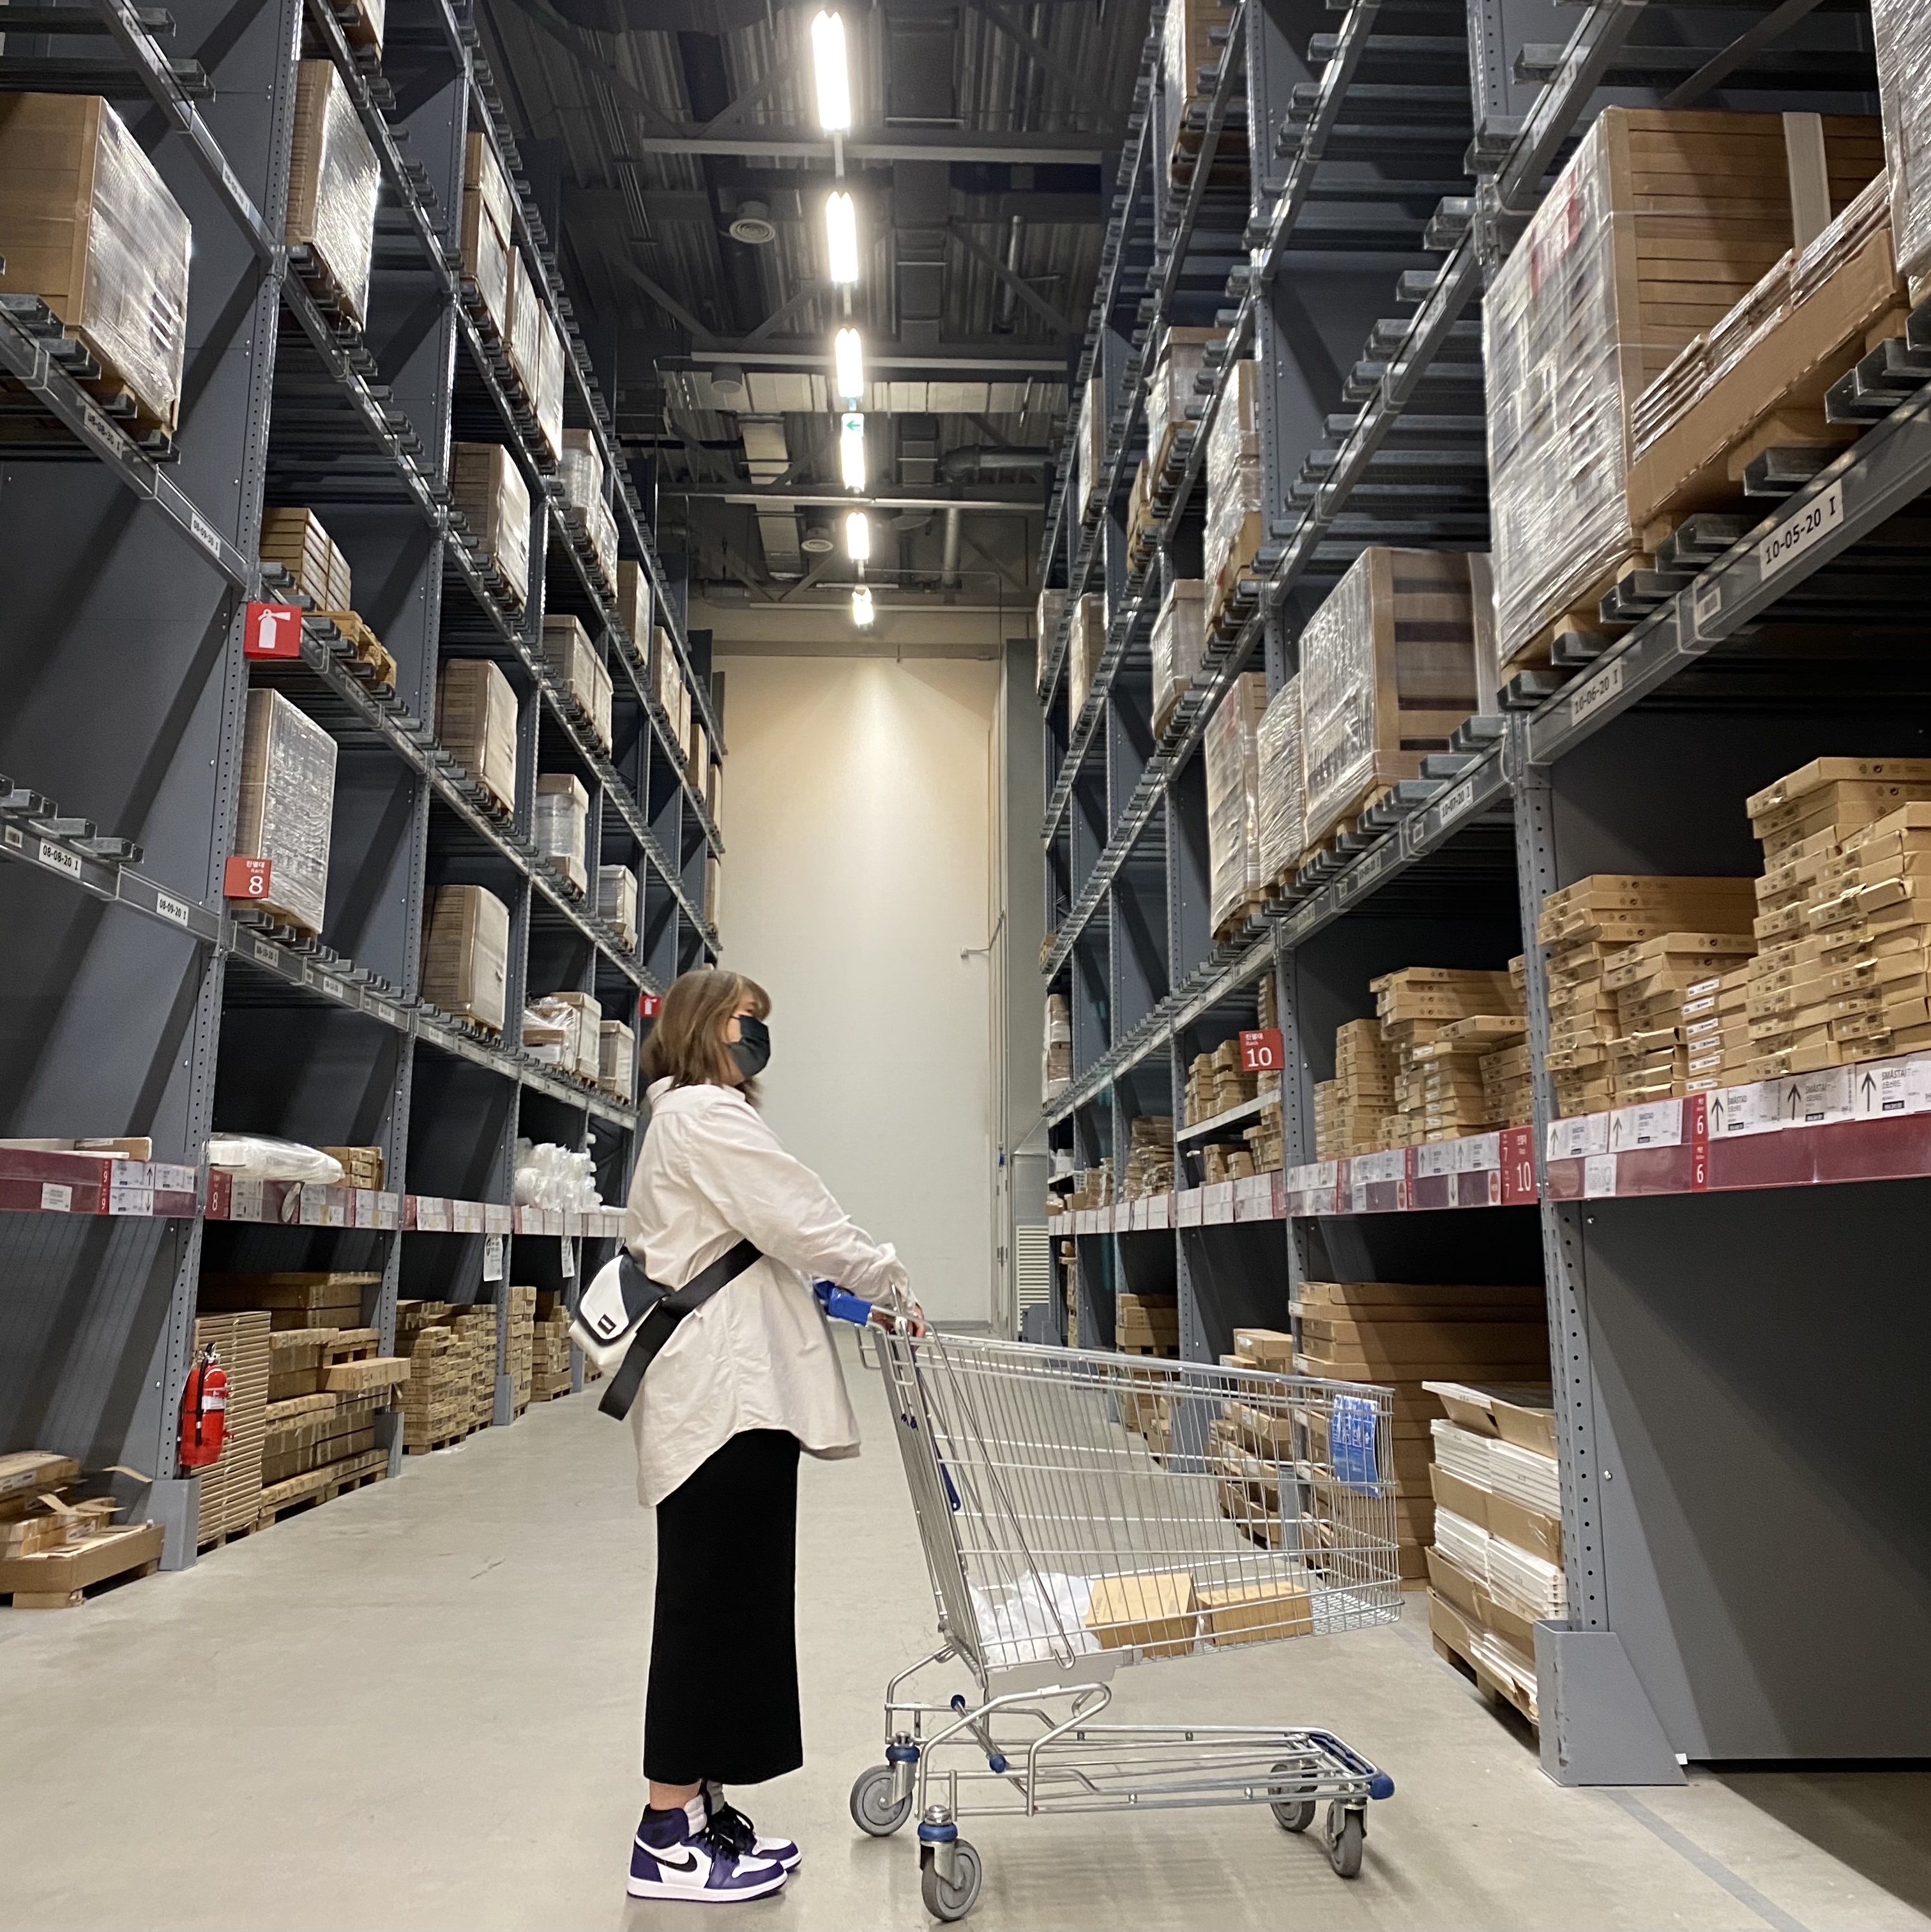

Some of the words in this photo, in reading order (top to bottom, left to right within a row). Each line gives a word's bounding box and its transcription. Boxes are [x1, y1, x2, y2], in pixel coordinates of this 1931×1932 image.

[1766, 508, 1822, 565] 10-05-20
[1829, 496, 1836, 517] I
[1575, 676, 1610, 715] 10-06-20
[43, 844, 72, 867] 08-08-20
[248, 875, 264, 895] 8
[159, 899, 182, 918] 08-09-20
[1246, 1046, 1273, 1067] 10
[1697, 1114, 1704, 1135] 6
[1503, 1146, 1508, 1162] 7
[1517, 1161, 1531, 1192] 10
[1697, 1163, 1704, 1183] 6
[212, 1191, 218, 1212] 8
[1504, 1183, 1510, 1199] 7
